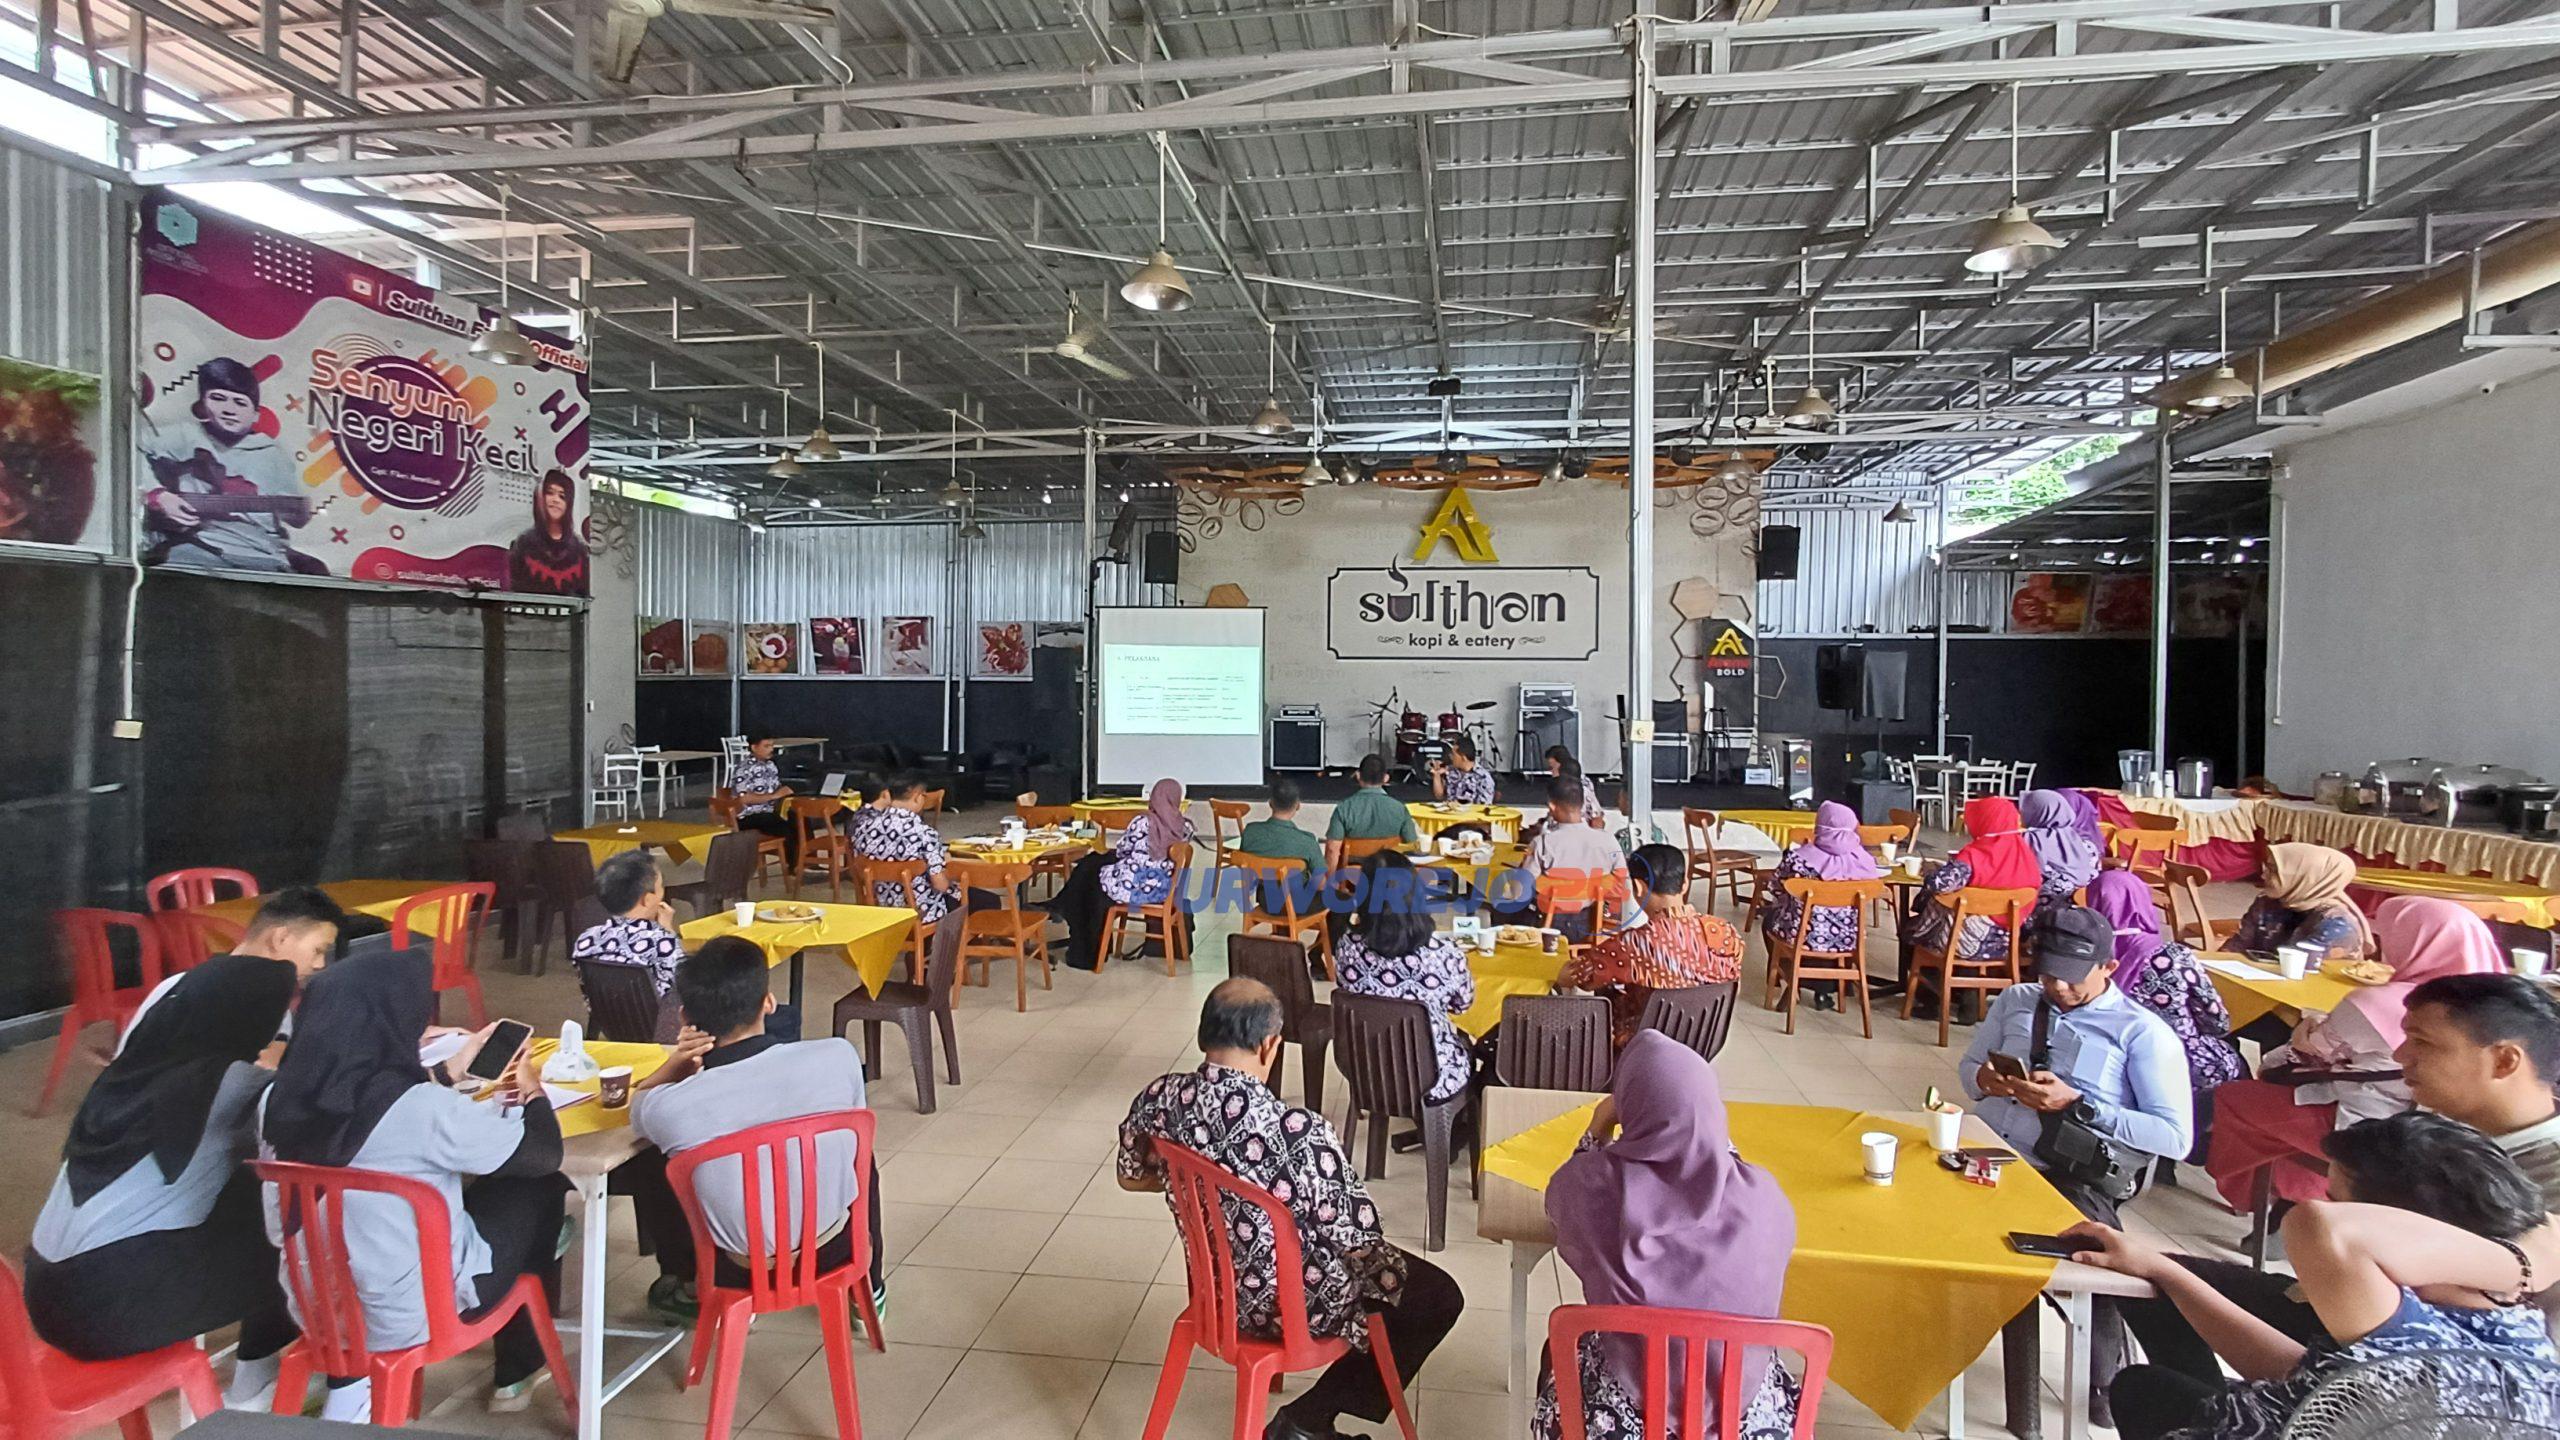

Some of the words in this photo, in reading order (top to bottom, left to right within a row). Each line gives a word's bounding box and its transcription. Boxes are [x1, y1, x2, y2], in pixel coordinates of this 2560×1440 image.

[388, 290, 468, 336] Sulthan
[529, 340, 588, 373] Official
[309, 348, 473, 425] Senyum
[307, 388, 444, 455] Negeri
[457, 424, 542, 476] Kecil
[1359, 578, 1566, 630] sulthan
[1409, 633, 1443, 649] kopi
[1448, 633, 1459, 646] &
[1465, 633, 1516, 650] eatery
[1716, 668, 1745, 676] BOLD
